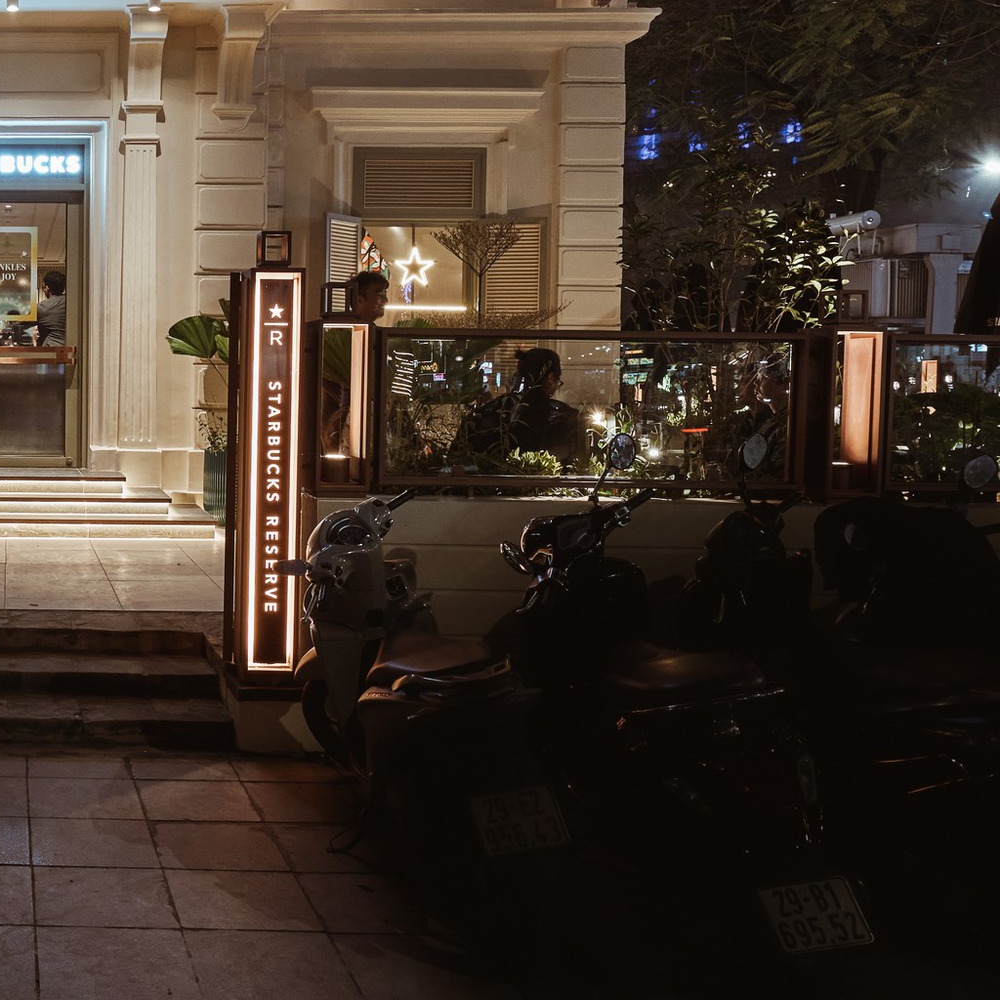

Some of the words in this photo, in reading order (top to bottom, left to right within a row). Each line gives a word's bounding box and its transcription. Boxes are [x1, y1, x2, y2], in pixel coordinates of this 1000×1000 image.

[1, 272, 17, 281] JOY
[270, 330, 283, 346] R
[266, 381, 282, 502] STARBUCKS
[264, 515, 279, 612] RESERVE
[772, 881, 841, 917] 29-B1
[778, 912, 865, 949] 695.52
